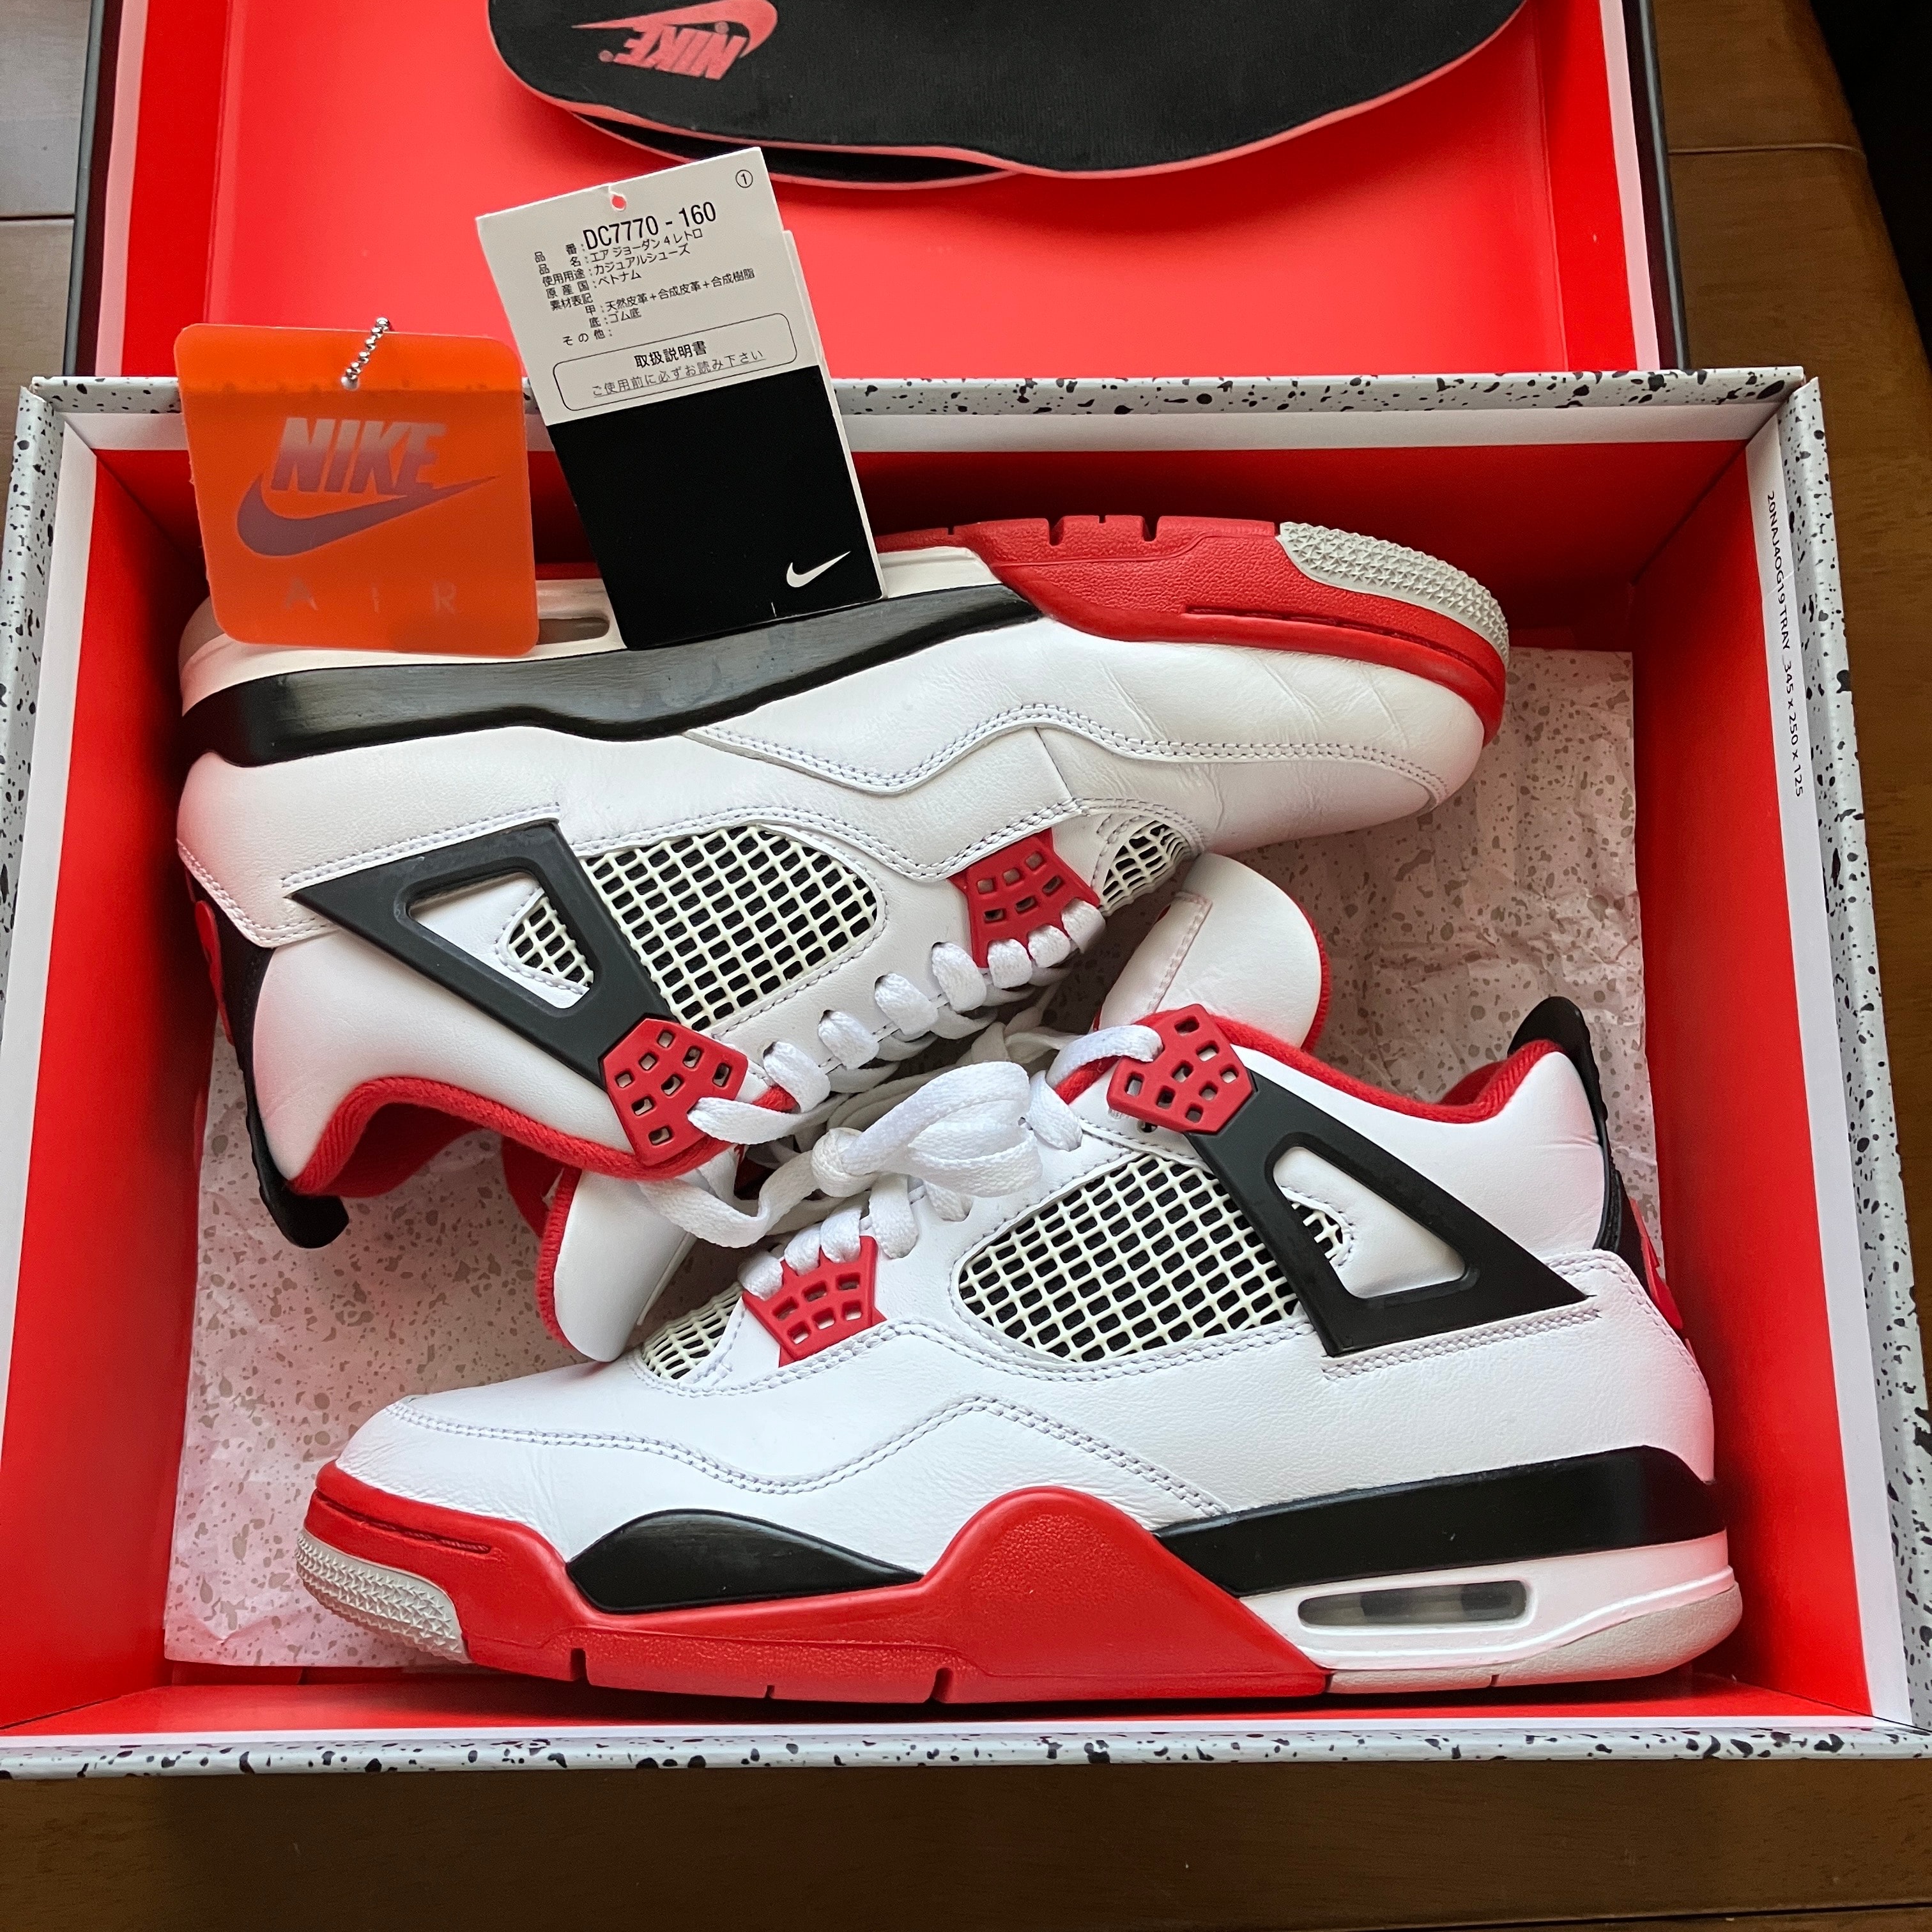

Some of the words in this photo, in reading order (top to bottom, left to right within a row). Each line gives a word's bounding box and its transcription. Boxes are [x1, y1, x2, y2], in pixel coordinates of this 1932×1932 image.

[613, 25, 747, 80] NIKE
[592, 350, 764, 397] ご使用前に必ずお読み下さい
[634, 341, 707, 369] 取扱説明書
[270, 416, 447, 496] NIKE
[1779, 604, 1791, 650] TRAY
[1789, 712, 1798, 746] 250
[1794, 764, 1804, 797] 125
